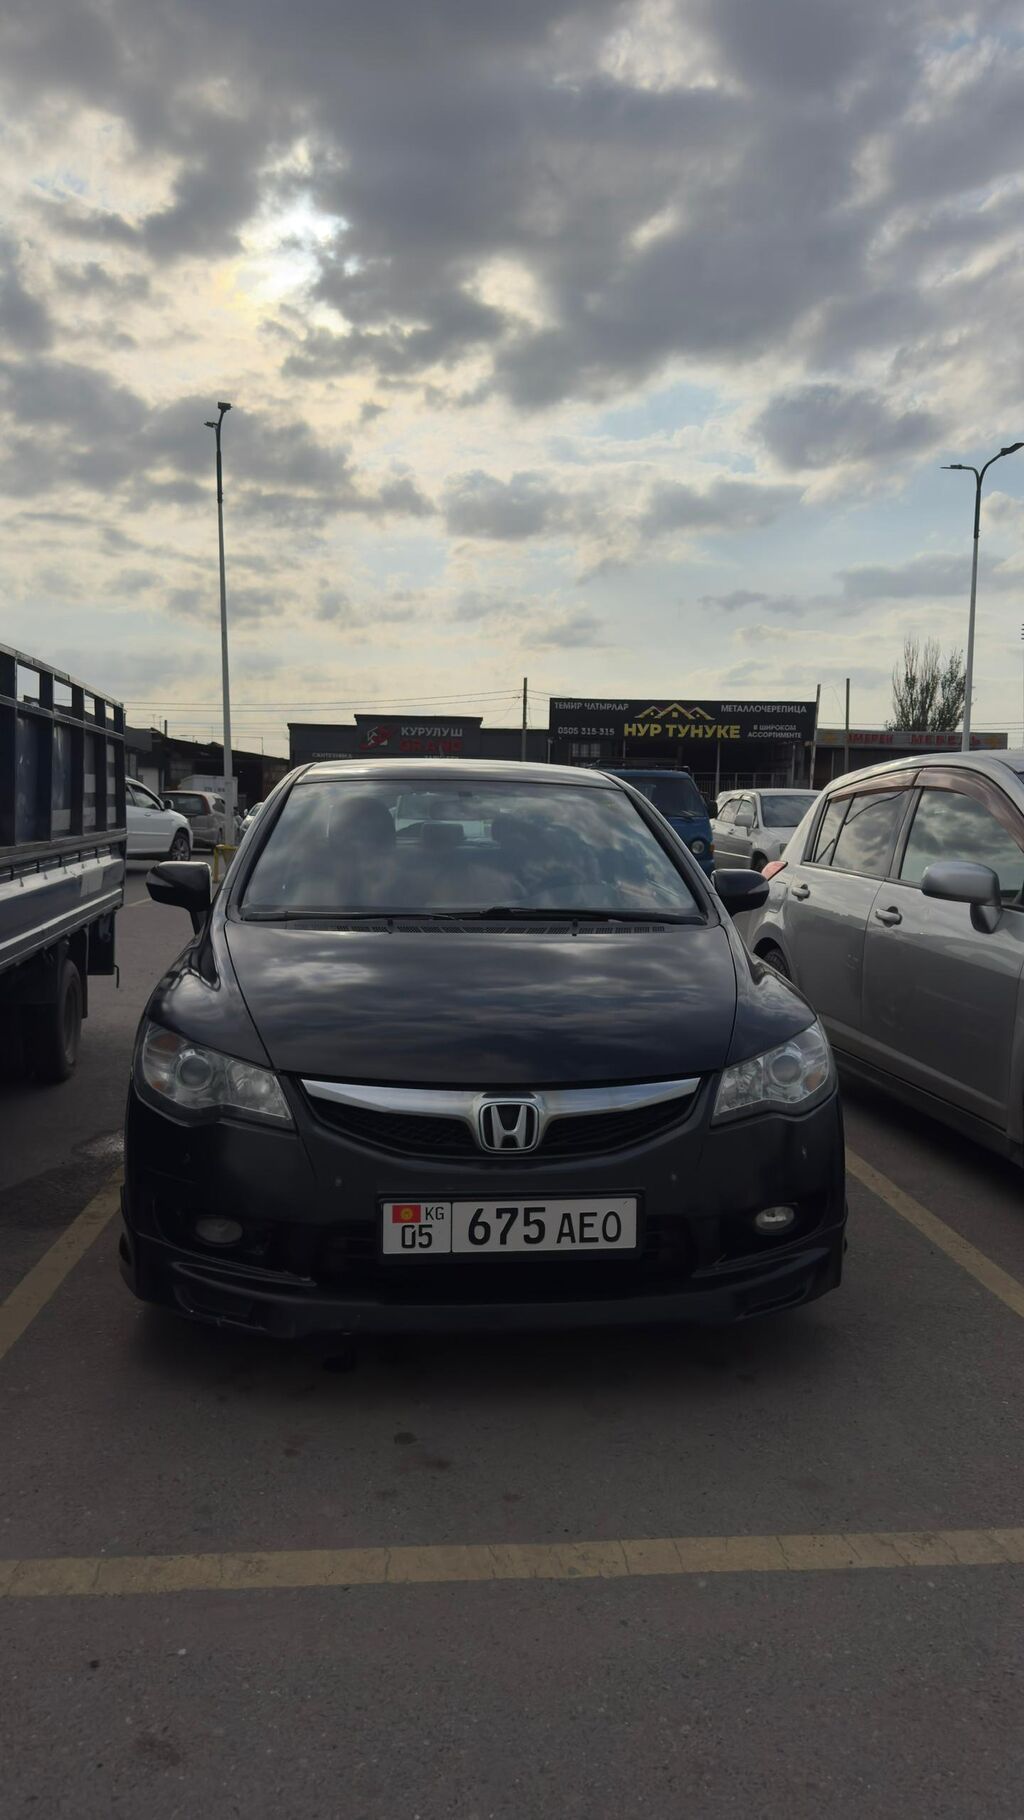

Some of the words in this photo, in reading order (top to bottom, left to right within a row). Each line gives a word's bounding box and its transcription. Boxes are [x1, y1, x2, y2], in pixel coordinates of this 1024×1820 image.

[555, 702, 582, 710] ТЕМИР
[584, 703, 629, 711] ЧАТЫРЛАР
[721, 704, 807, 714] МЕТАЛЛОЧЕРЕПИЦА
[401, 727, 464, 737] КУРУЛУШ
[624, 723, 662, 737] НУР
[665, 724, 740, 739] ТУНУКЕ
[747, 731, 802, 739] АССОРТИМЕНТЕ
[425, 1206, 445, 1221] KG
[468, 1207, 546, 1246] 675
[556, 1211, 622, 1244] AEO
[401, 1224, 433, 1249] 05
